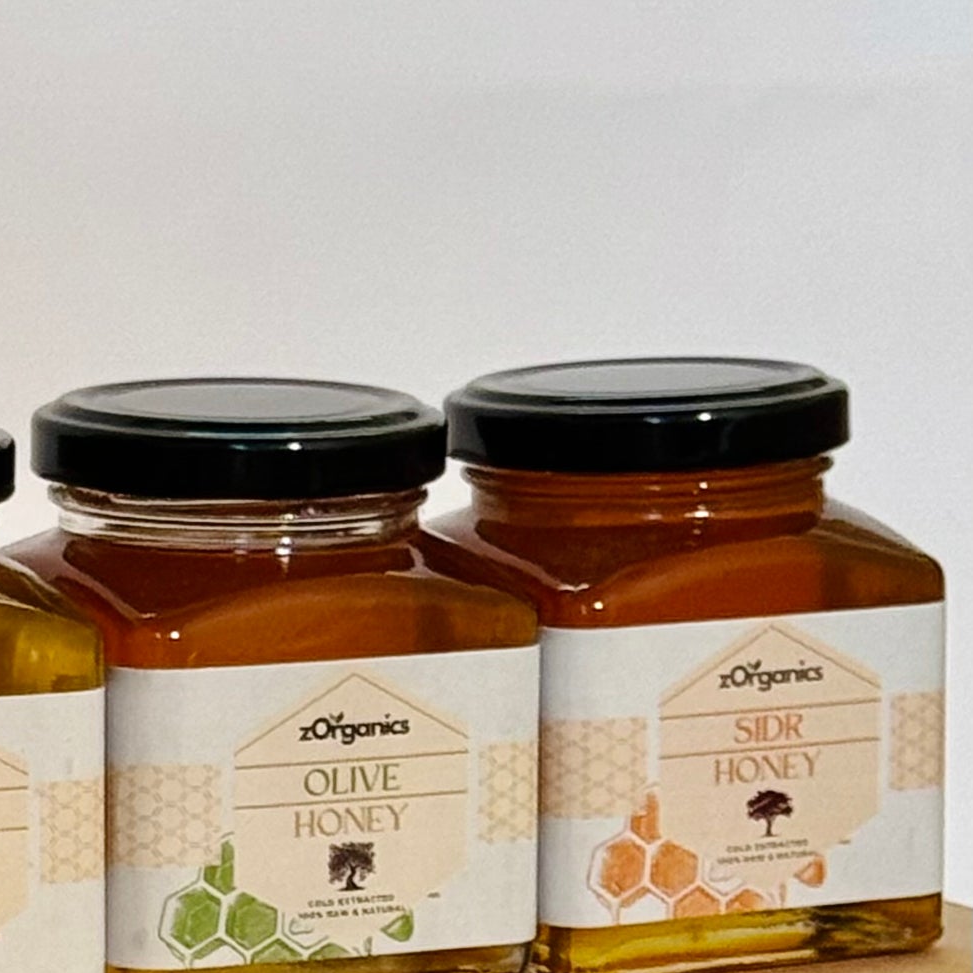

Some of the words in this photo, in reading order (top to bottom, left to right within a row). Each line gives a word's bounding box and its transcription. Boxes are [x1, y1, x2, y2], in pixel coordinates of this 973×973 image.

[719, 659, 824, 692] zOrganics
[299, 711, 410, 745] zOrganics
[734, 713, 803, 744] SIDR
[304, 763, 401, 796] OLIVE
[714, 747, 821, 785] HONEY
[294, 803, 409, 838] HONEY
